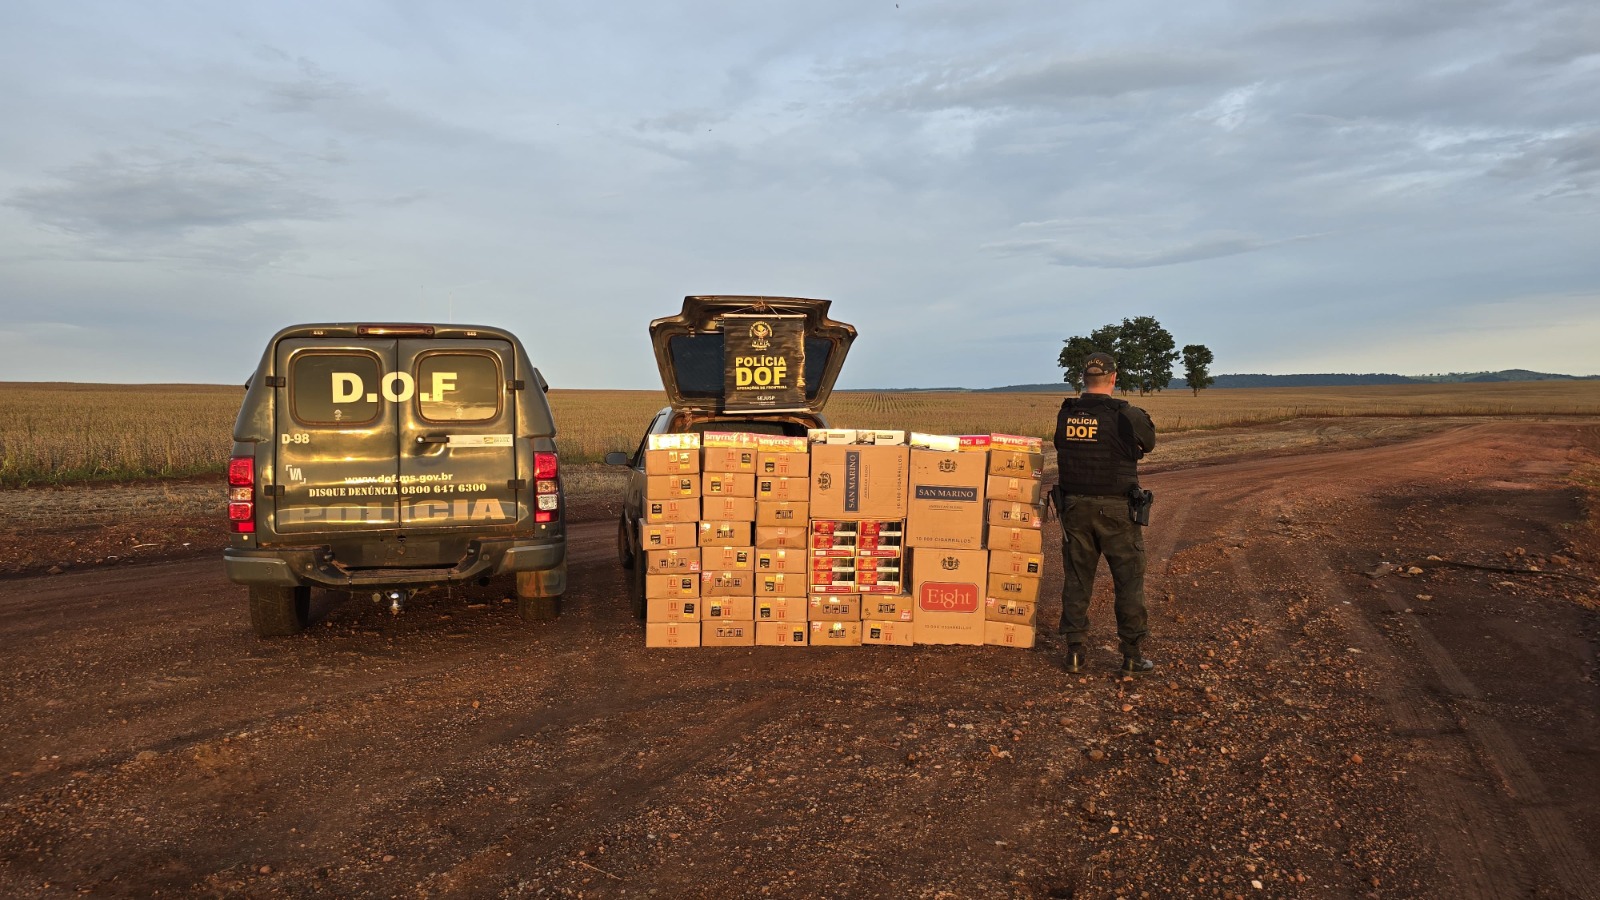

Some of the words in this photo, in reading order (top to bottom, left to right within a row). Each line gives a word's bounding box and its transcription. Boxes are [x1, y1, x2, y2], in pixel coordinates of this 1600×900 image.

[736, 355, 787, 367] POLÍCIA
[736, 366, 787, 386] DOF
[331, 371, 458, 403] D.O.F
[1067, 417, 1098, 425] POLÍCIA
[281, 433, 310, 444] D-98
[1066, 425, 1098, 438] DOF
[345, 472, 454, 484] www.dof.ms.gov.br
[849, 455, 857, 489] MARINO
[309, 487, 346, 497] DISQUE
[348, 485, 398, 496] DENÚNCIA
[401, 485, 431, 494] 0800
[433, 484, 455, 493] 647
[458, 483, 487, 492] 6300
[937, 490, 974, 498] MARINO
[848, 491, 856, 508] SAN
[289, 497, 506, 524] POLÍCIA
[926, 588, 972, 608] Eight
